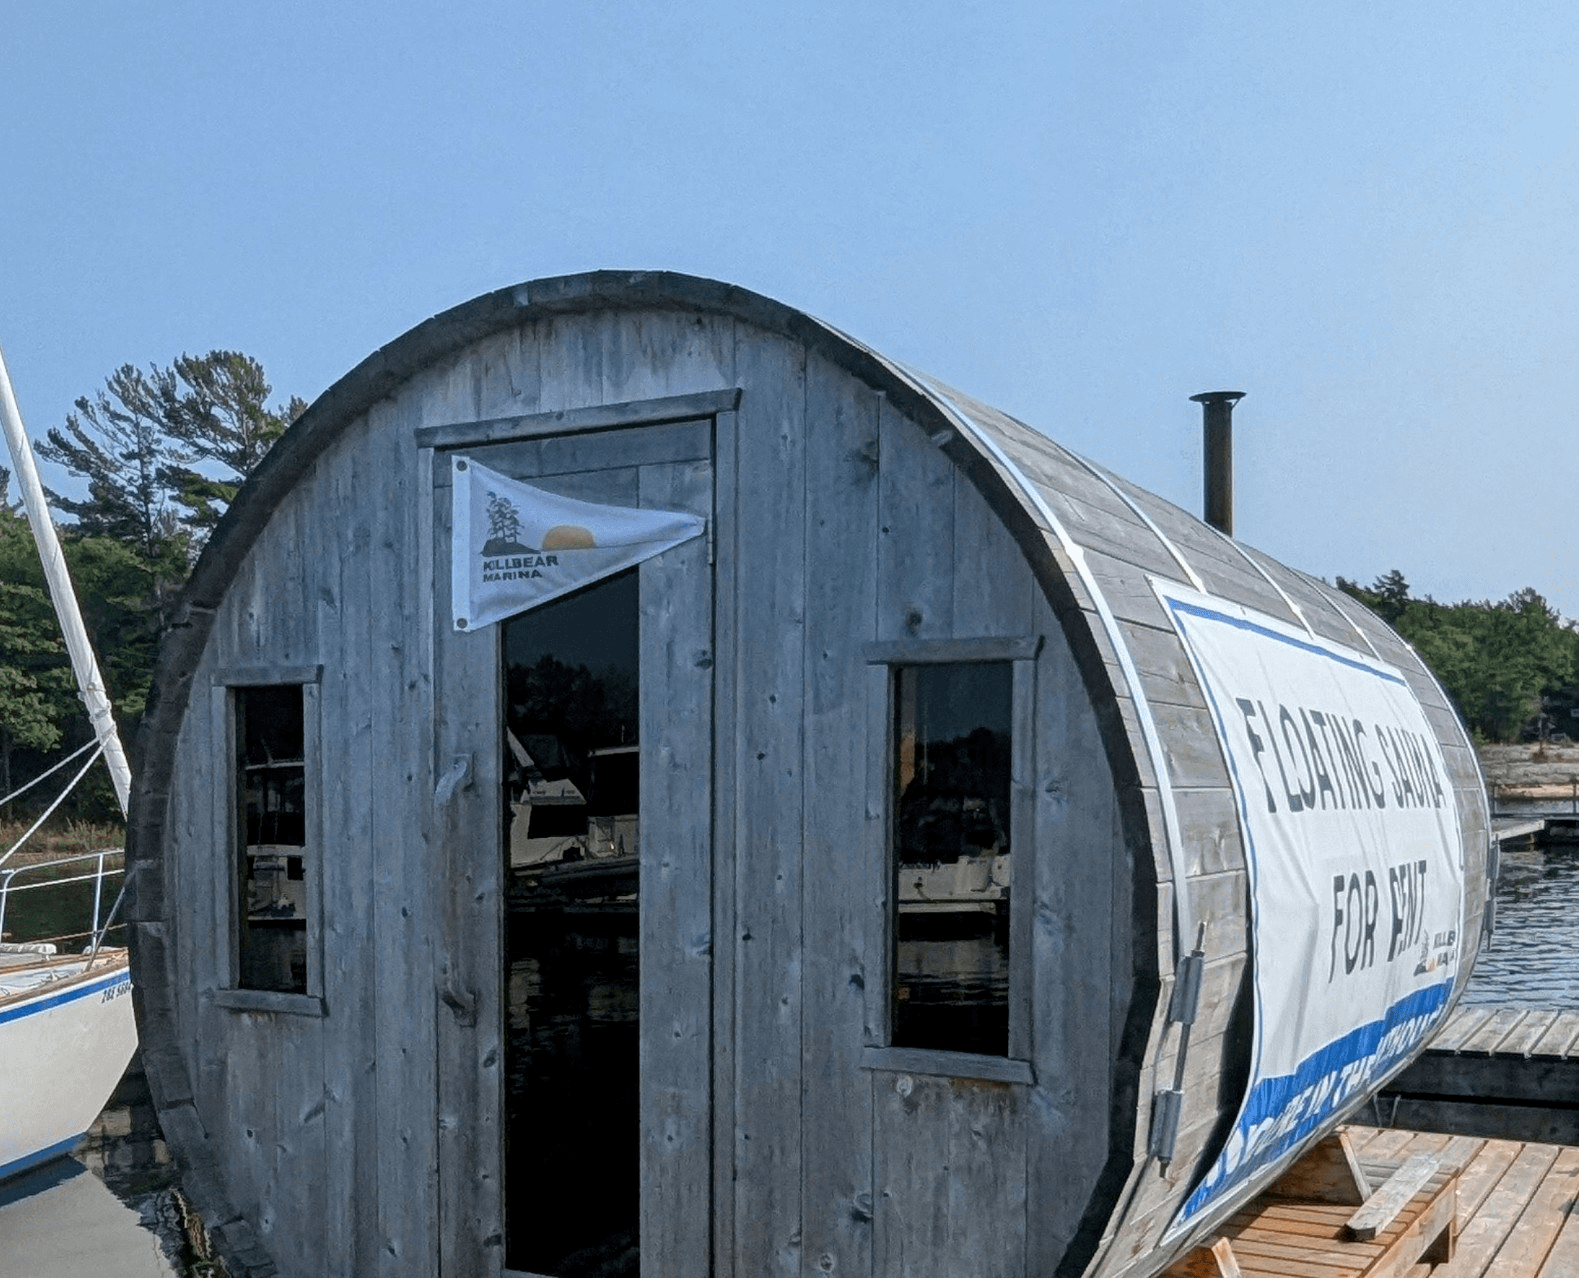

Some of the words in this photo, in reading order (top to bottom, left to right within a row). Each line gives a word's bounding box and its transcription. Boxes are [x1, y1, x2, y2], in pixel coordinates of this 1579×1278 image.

[484, 556, 559, 571] KILLBEAR
[484, 570, 543, 582] MARINA
[1236, 697, 1386, 814] FLOATING
[1374, 723, 1447, 809] SAUNA
[1328, 870, 1378, 984] FOR
